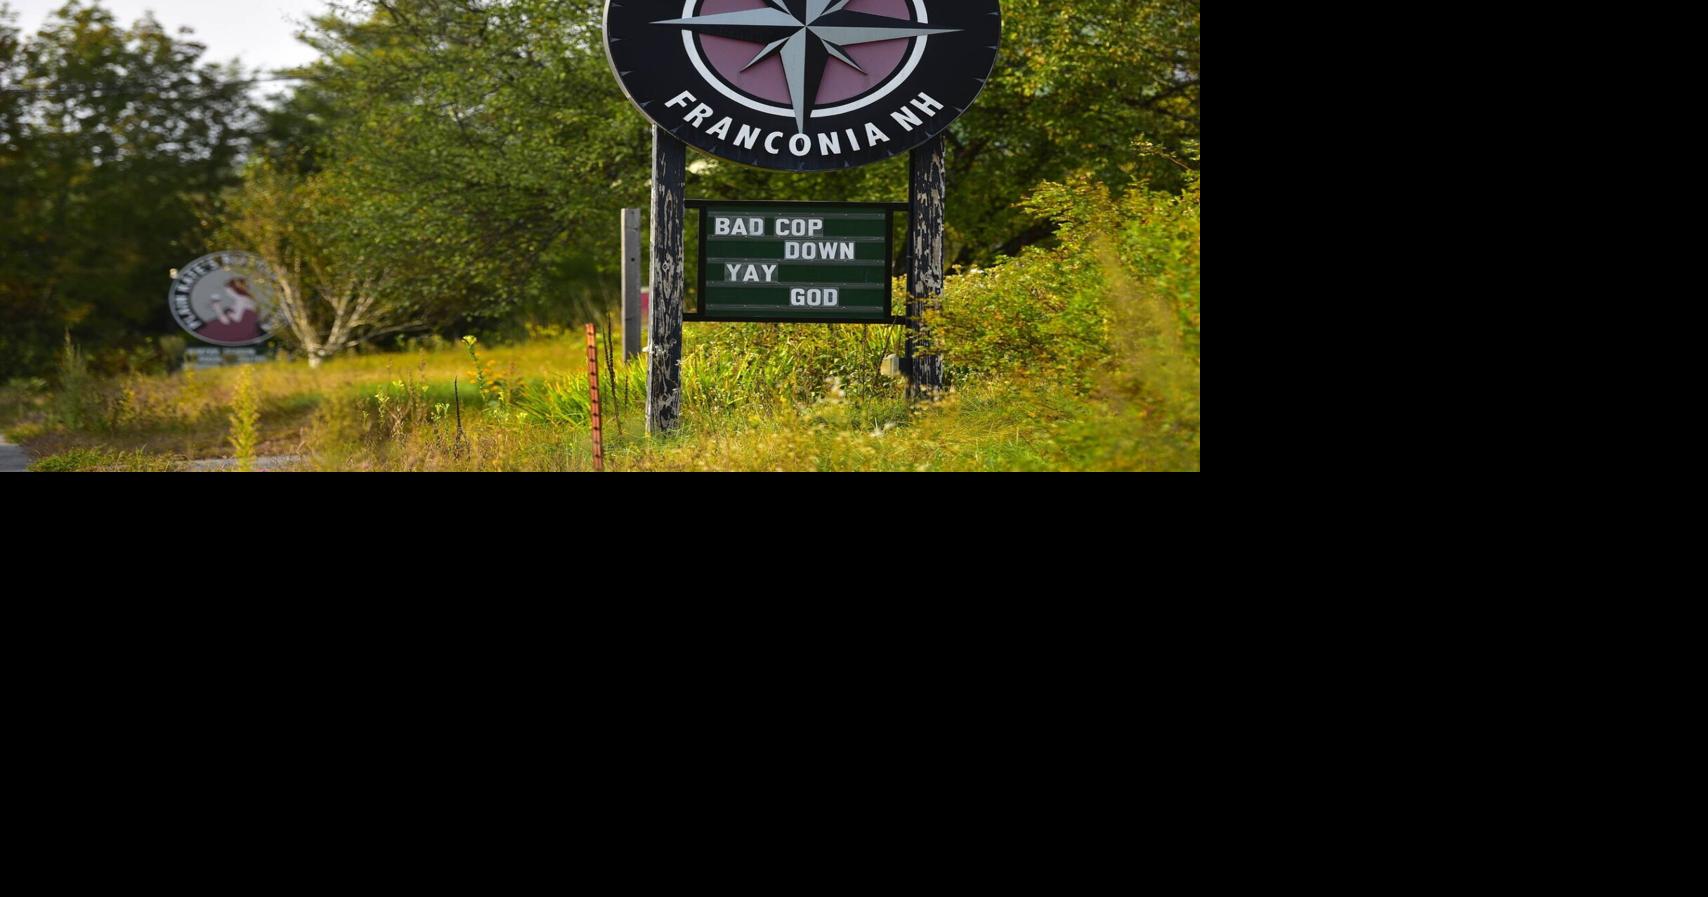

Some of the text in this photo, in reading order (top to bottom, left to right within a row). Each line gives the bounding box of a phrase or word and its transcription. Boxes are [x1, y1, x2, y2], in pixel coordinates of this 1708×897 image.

[664, 89, 945, 157] FRANCONIA NH
[714, 217, 823, 236] BAD COP
[784, 241, 855, 260] DOWN
[727, 264, 777, 282] YAY
[790, 288, 838, 306] GOD
